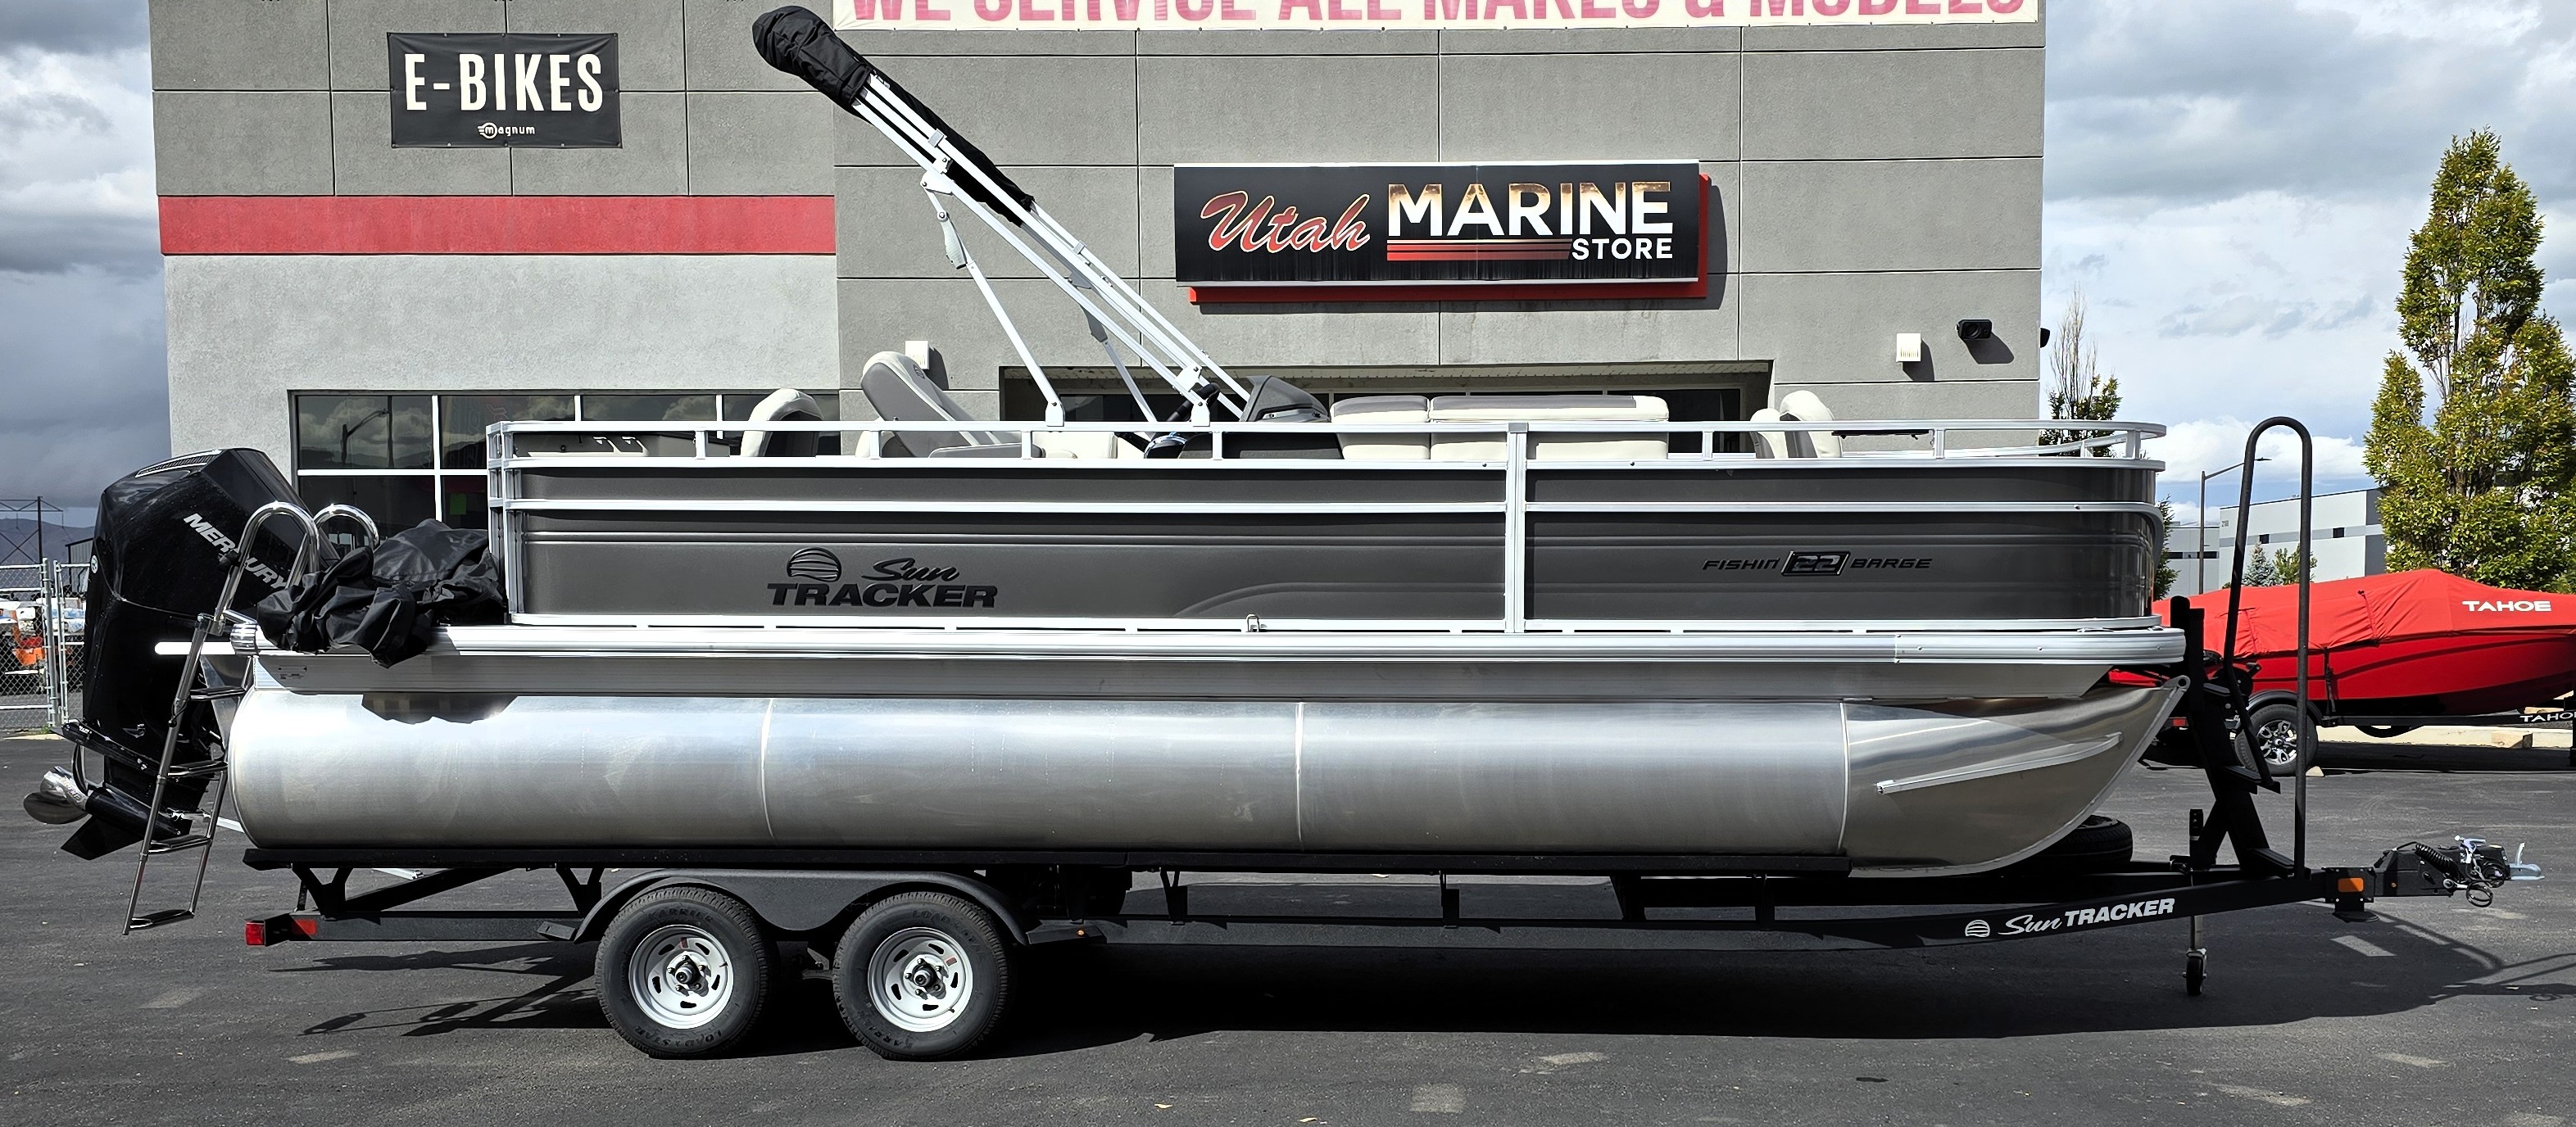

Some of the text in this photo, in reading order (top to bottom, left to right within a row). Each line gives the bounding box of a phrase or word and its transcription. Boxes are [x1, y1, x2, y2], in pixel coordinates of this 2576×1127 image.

[405, 53, 603, 111] E-BIKES
[478, 123, 535, 138] magnum
[1200, 182, 1673, 253] Utah MARINE
[1571, 238, 1673, 260] STORE
[183, 513, 288, 590] MERURY
[1792, 554, 1841, 572] 22
[1850, 558, 1933, 568] BARGE
[861, 557, 960, 582] Sun
[767, 582, 998, 608] TRACKER
[2462, 600, 2551, 612] TAHOE
[2519, 712, 2576, 722] TAHO
[1998, 898, 2175, 935] Sun TRACKER
